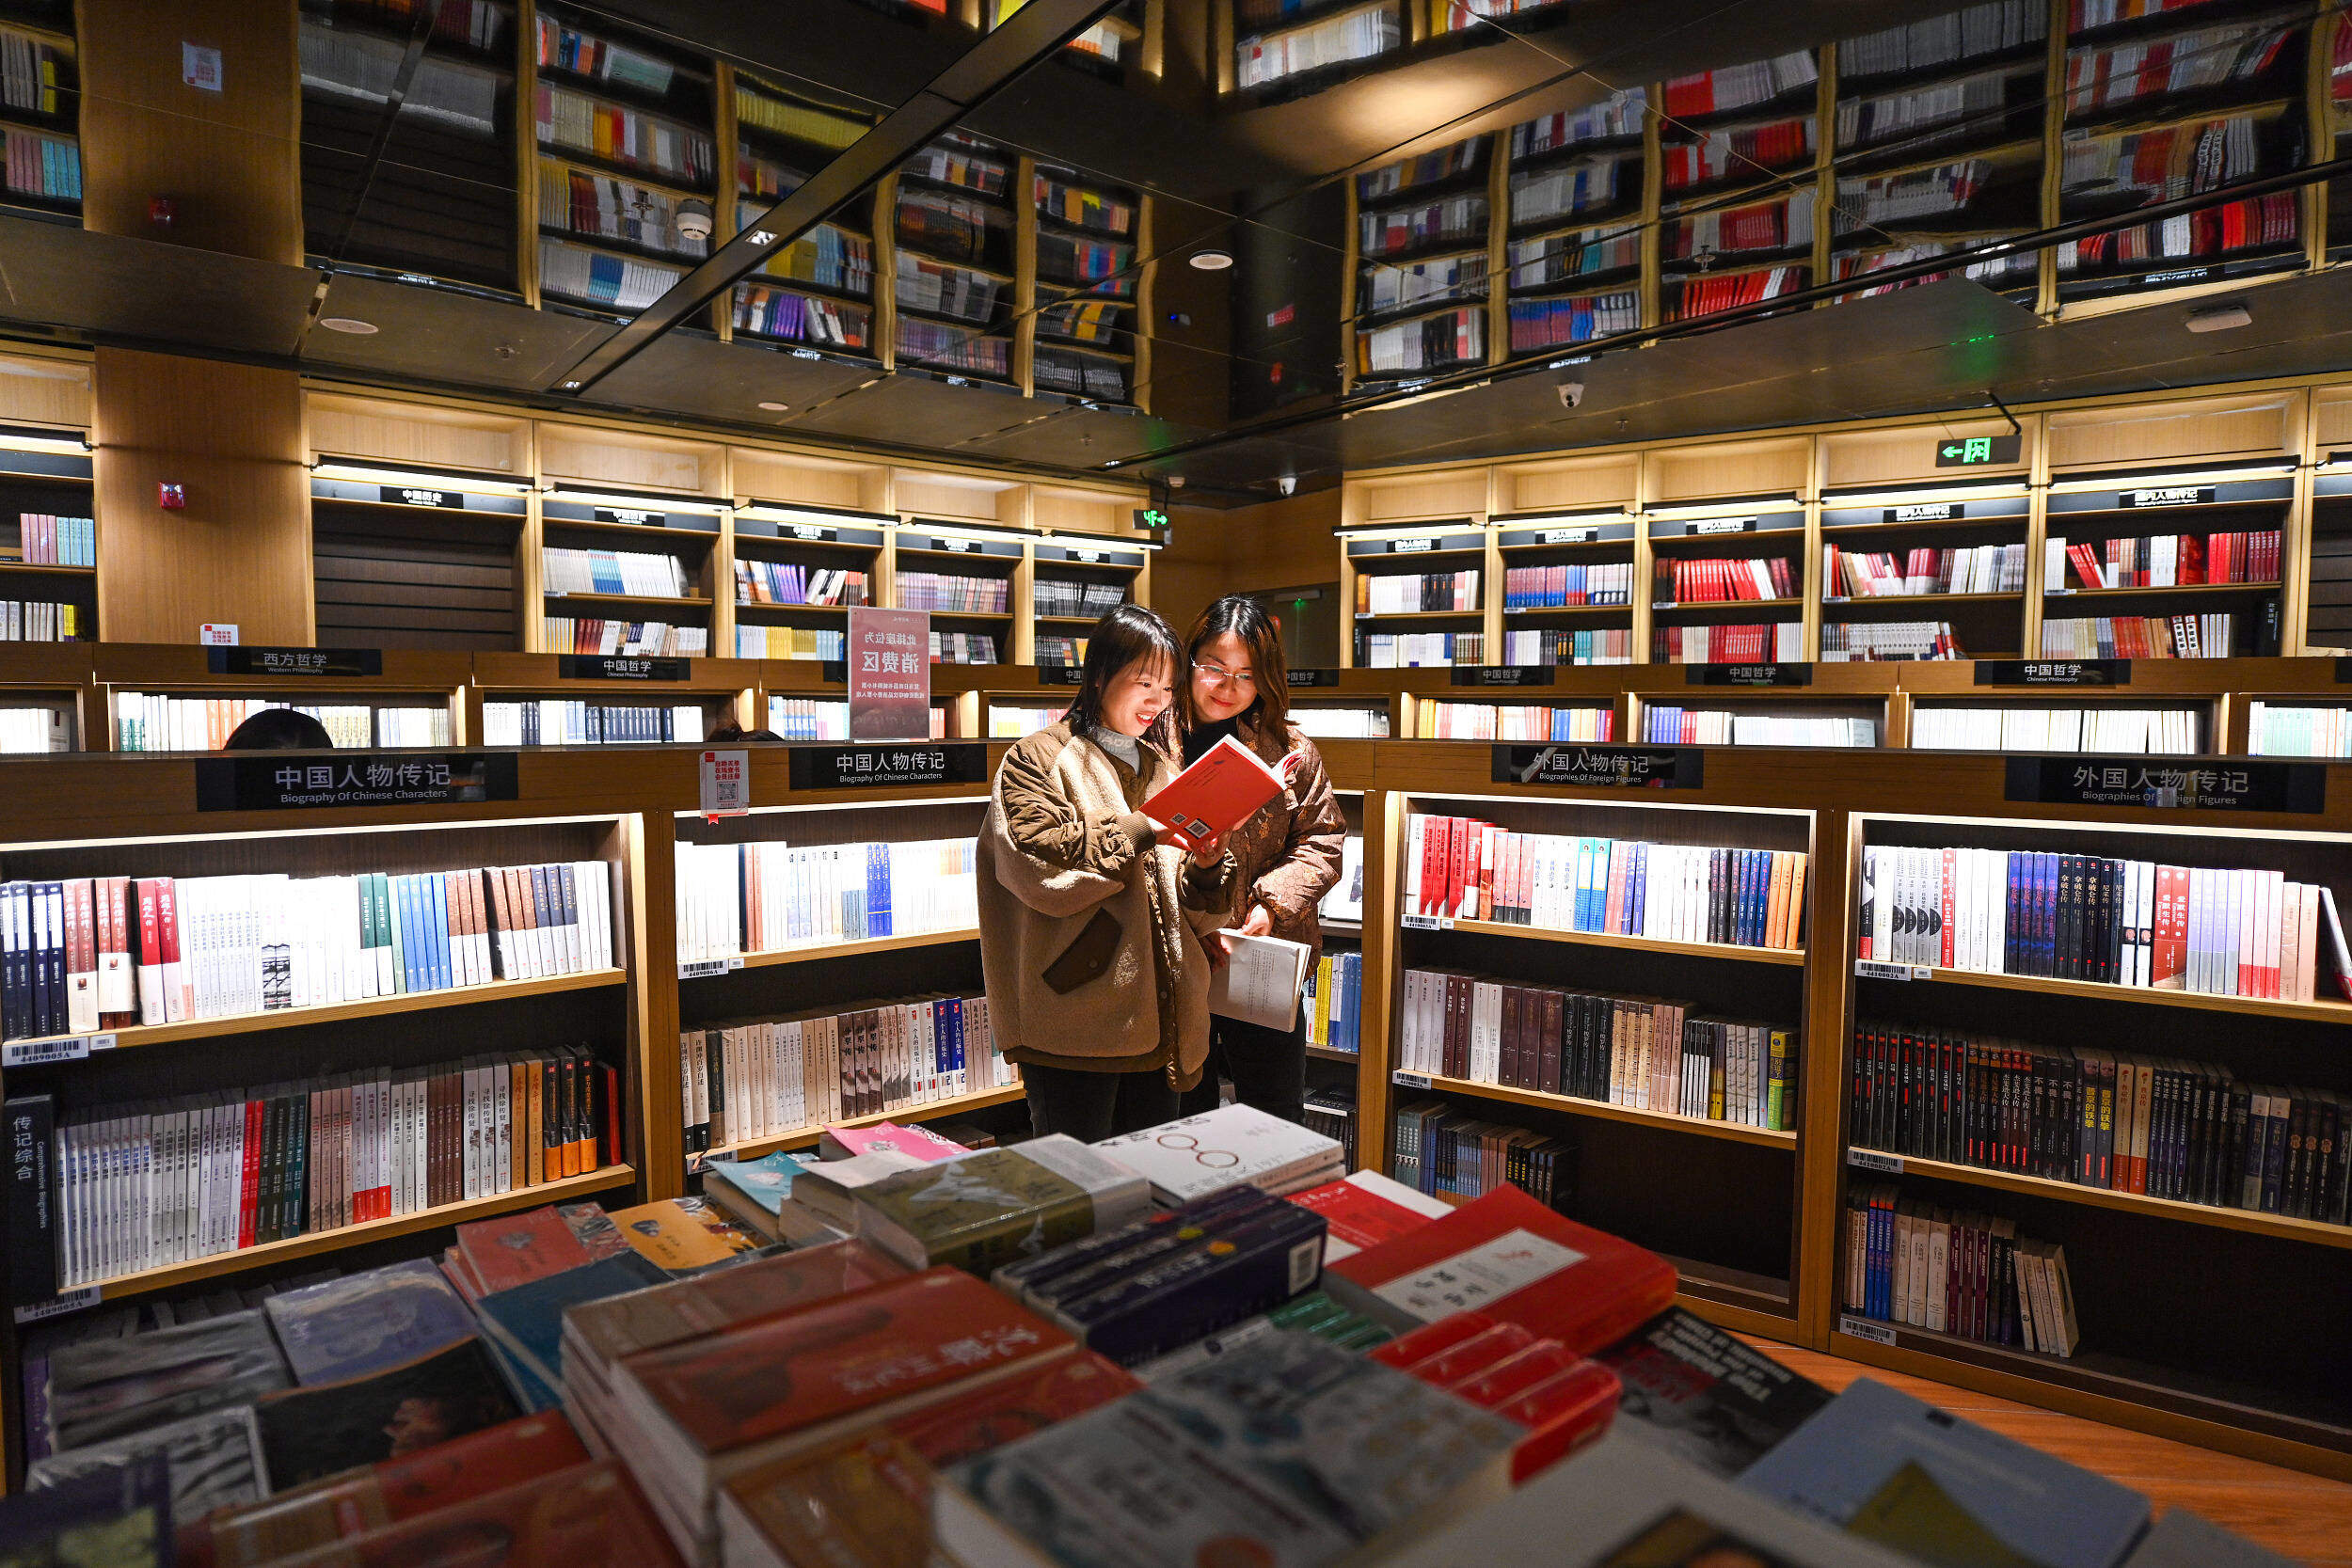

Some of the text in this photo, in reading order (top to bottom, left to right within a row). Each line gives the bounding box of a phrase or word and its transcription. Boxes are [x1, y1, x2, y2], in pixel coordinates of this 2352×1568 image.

[402, 489, 442, 503] 中国历史
[2134, 488, 2199, 502] 国内人物传记
[1143, 510, 1158, 527] 4F
[263, 653, 327, 667] 西方哲学
[603, 659, 651, 673] 中国哲学
[2025, 664, 2082, 676] 中国哲学
[1483, 669, 1521, 679] 中国哲学
[1729, 667, 1776, 678] 中国哲学
[836, 752, 945, 772] 中国人物传记
[1534, 752, 1649, 773] 外国人物传记
[275, 764, 452, 790] 中国人物传记
[840, 775, 873, 784] Biography
[910, 772, 943, 781] Characters
[1539, 772, 1579, 782] Biographies
[1589, 773, 1614, 784] Foreign
[1616, 775, 1642, 784] Figures
[2073, 766, 2249, 793] 外国人物传记
[280, 789, 448, 805] Biography Of Chinese Characters
[2082, 791, 2141, 801] Biographies
[2142, 792, 2155, 800] Of
[2199, 795, 2237, 806] Figures
[2060, 874, 2069, 903] 拿破仑传
[2074, 875, 2083, 904] 拿破仑传
[2087, 876, 2097, 906] 拿破仑传
[2102, 884, 2110, 904] 尼采传
[2115, 884, 2123, 904] 尼采传
[2162, 895, 2171, 927] 爱默生传
[2176, 895, 2186, 927] 爱默生传
[954, 1017, 962, 1054] 一个人的出版史
[21, 1052, 71, 1063] 4409005A
[2085, 1086, 2096, 1129] 普京的铁拳
[2100, 1089, 2112, 1132] 普京的铁拳
[13, 1117, 33, 1181] 传记综合
[1858, 1160, 1892, 1171] 4410002A
[36, 1140, 47, 1229] Comprehensive Biographies
[1851, 1330, 1884, 1342] 4410002A
